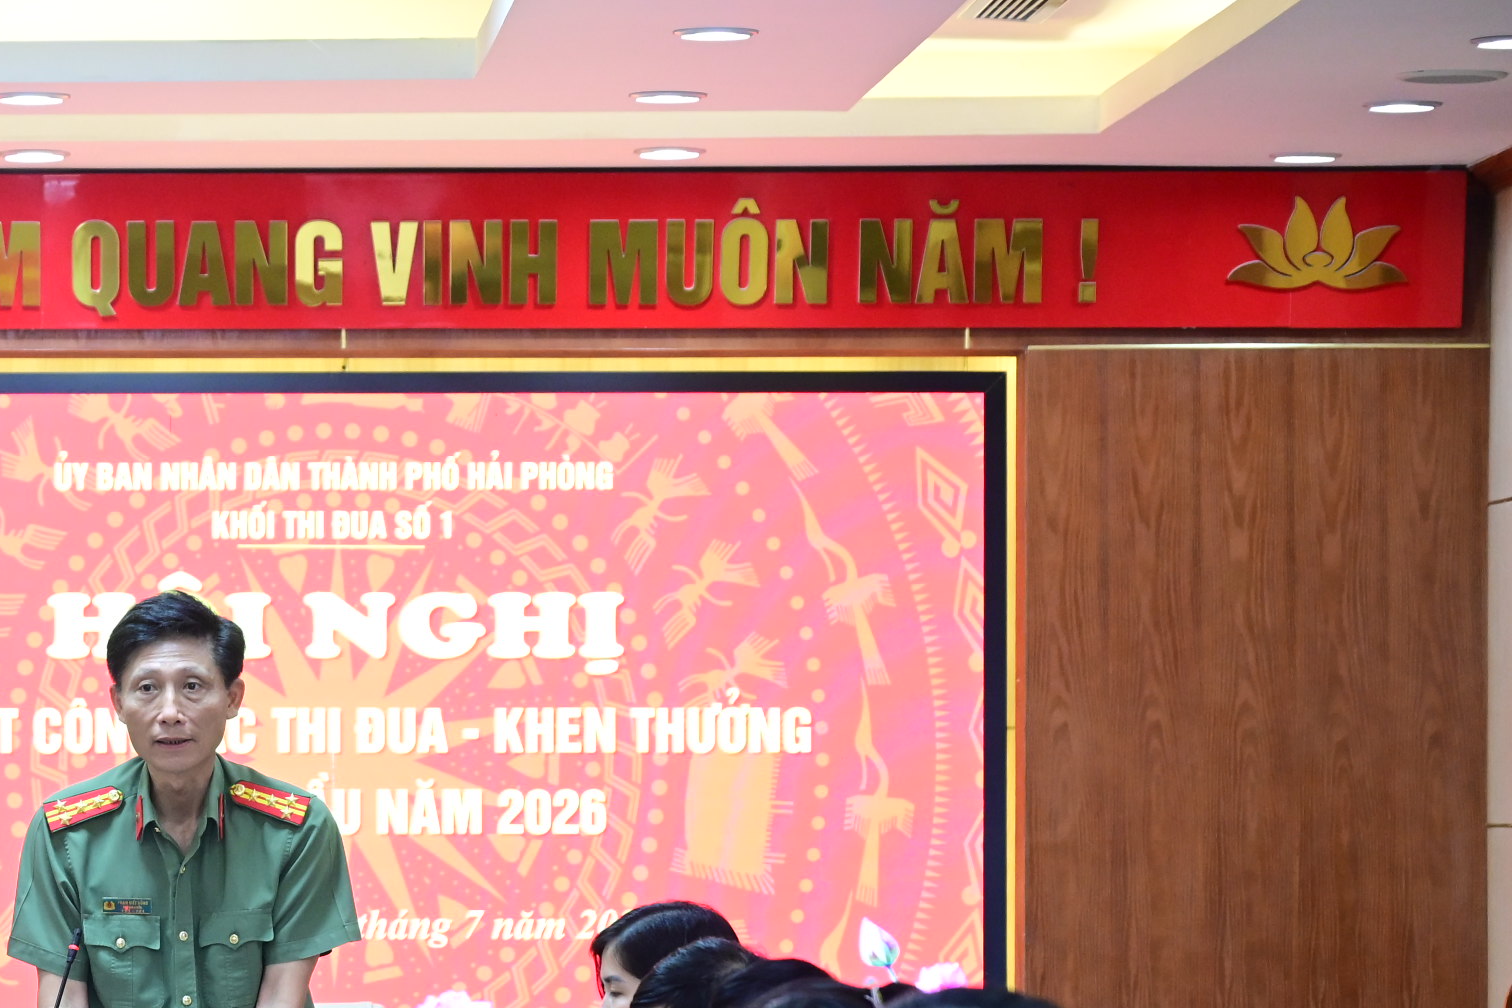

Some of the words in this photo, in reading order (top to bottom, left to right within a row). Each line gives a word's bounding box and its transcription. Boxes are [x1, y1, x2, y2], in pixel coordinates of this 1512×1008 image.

[72, 219, 343, 317] QUANG
[369, 219, 558, 306] VINH
[588, 197, 829, 305] MUÔN
[859, 199, 1043, 304] NĂM
[1078, 218, 1099, 303] !
[54, 450, 89, 491] ỦY
[96, 462, 153, 491] BAN
[160, 456, 236, 491] NHÂN
[244, 456, 300, 491] DÂN
[307, 456, 397, 491] THÀNH
[404, 452, 461, 491] PHỐ
[467, 450, 513, 491] HẢI
[520, 454, 614, 491] PHÒNG
[211, 500, 275, 540] KHỐI
[282, 510, 324, 540] THI
[332, 510, 387, 540] ĐUA
[394, 501, 432, 540] SỐ
[440, 511, 453, 539] 1
[46, 571, 272, 660] HI
[303, 591, 625, 675] NGHỊ
[33, 697, 128, 755] CÔN
[271, 707, 342, 753] THI
[354, 707, 449, 753] ĐUA
[493, 707, 617, 754] KHEN
[629, 687, 813, 754] THƯỞNG
[376, 778, 483, 835] NĂM
[497, 788, 608, 836] 2026
[464, 910, 485, 940] 7
[492, 911, 565, 940] năm
